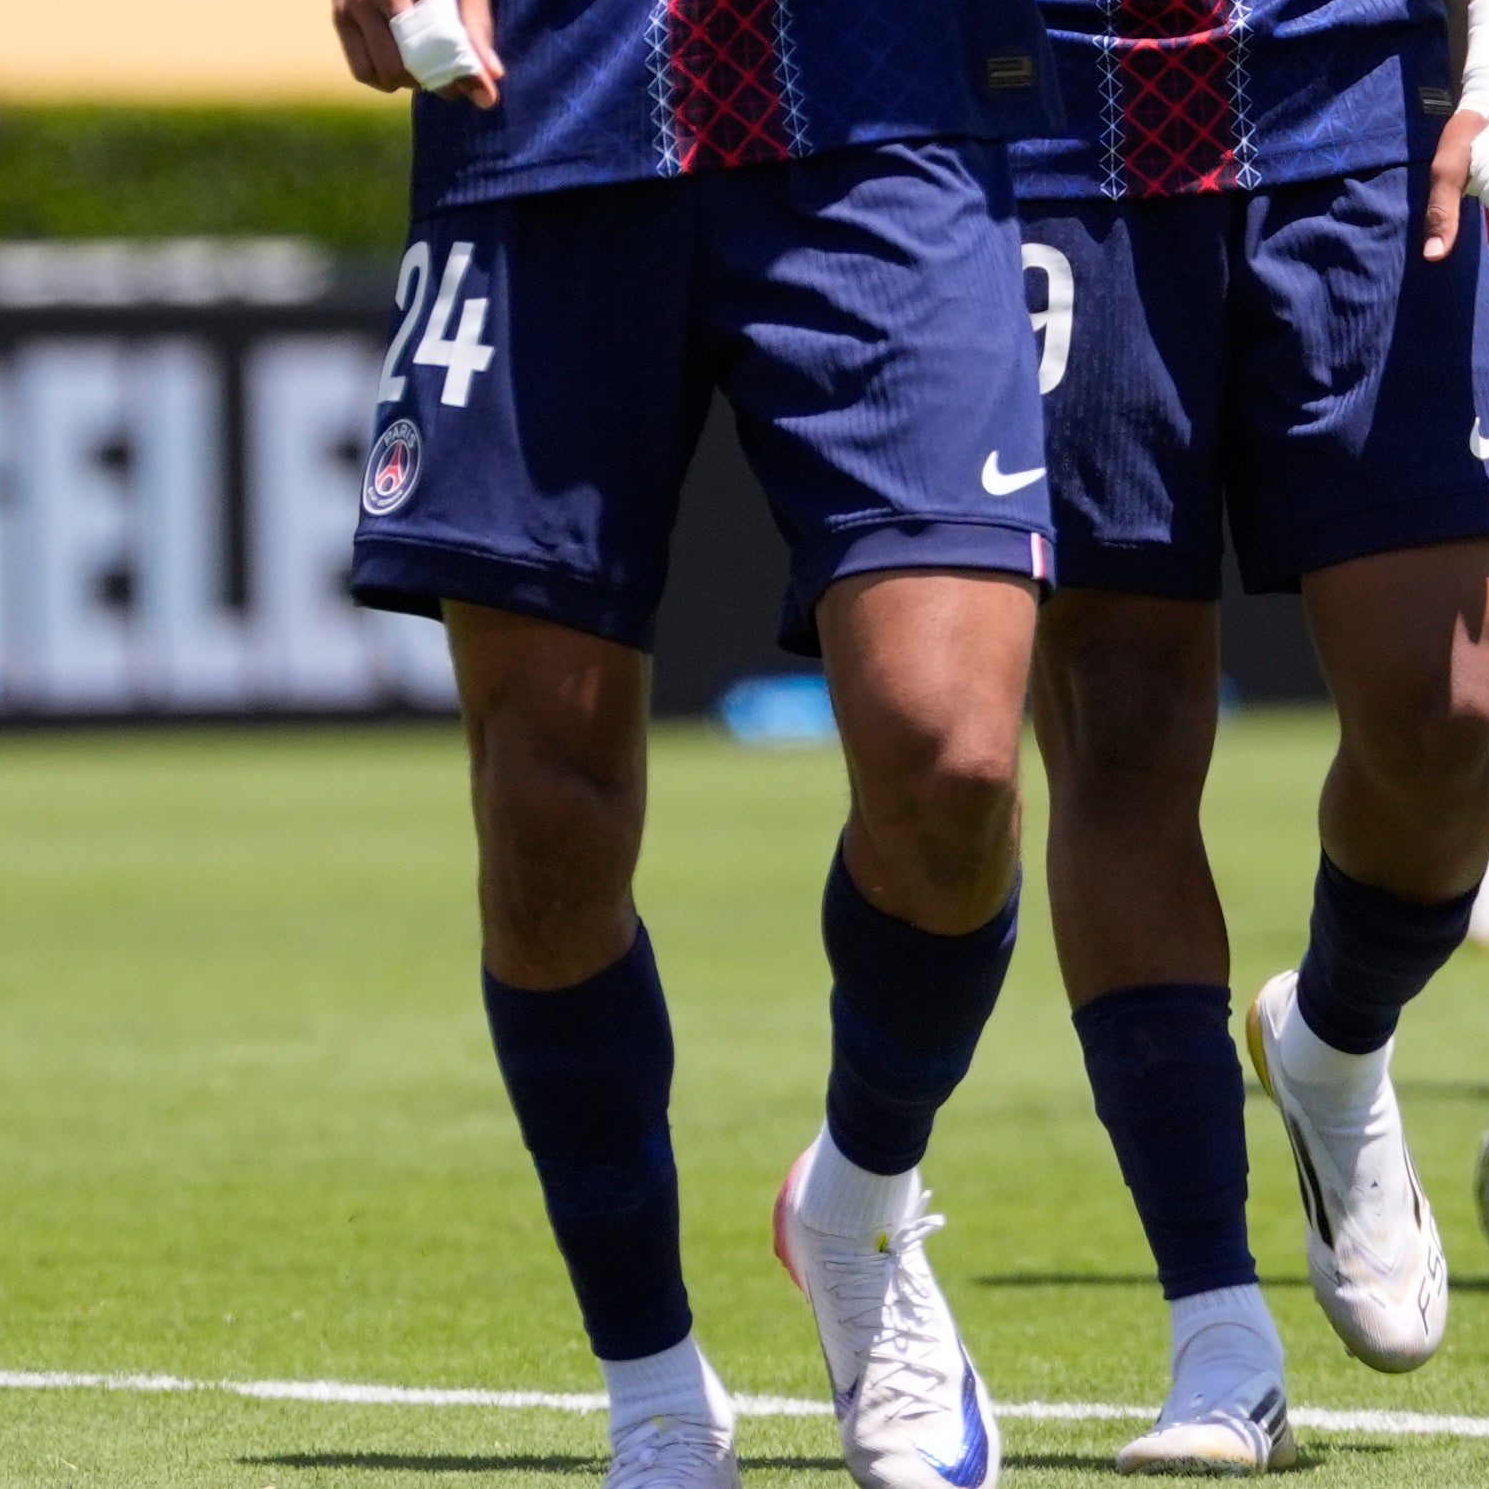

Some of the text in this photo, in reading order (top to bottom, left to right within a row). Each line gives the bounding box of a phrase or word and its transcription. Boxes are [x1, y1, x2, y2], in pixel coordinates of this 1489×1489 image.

[375, 241, 495, 408] 24
[1020, 242, 1075, 396] 9
[383, 423, 417, 448] PARIS
